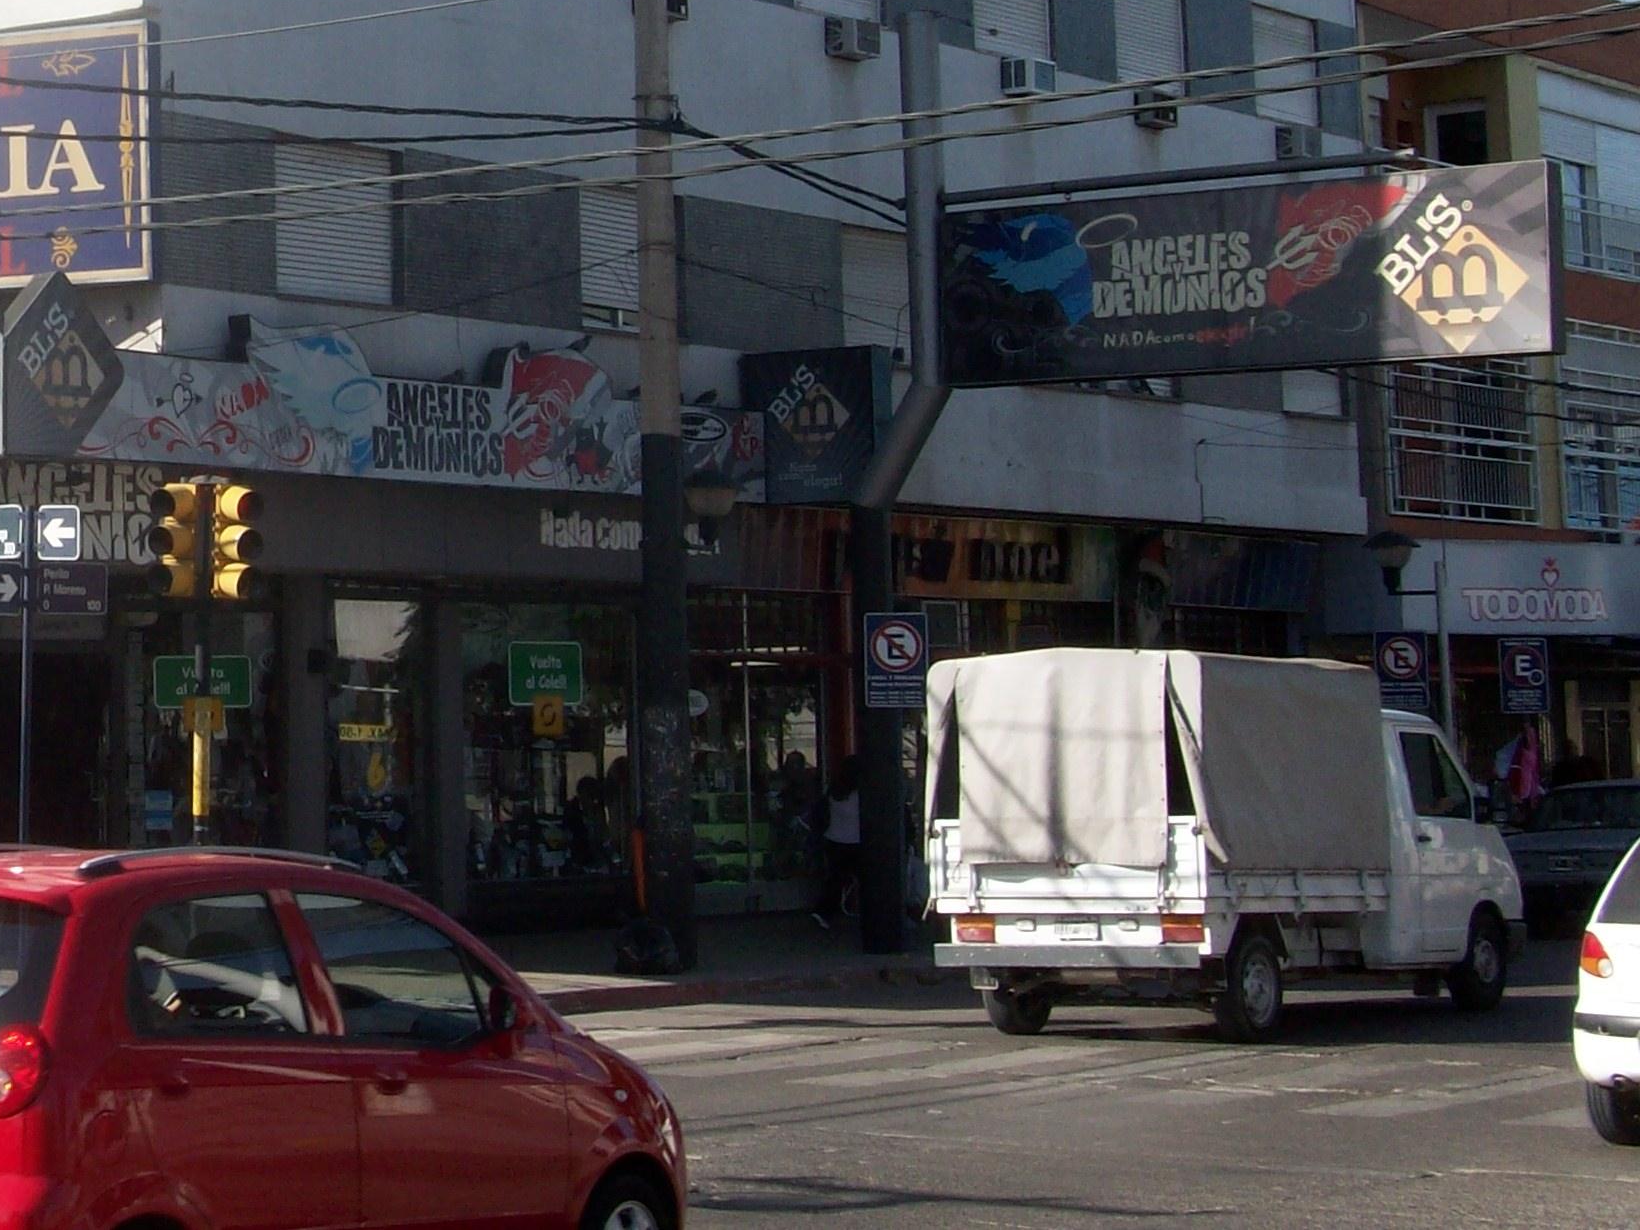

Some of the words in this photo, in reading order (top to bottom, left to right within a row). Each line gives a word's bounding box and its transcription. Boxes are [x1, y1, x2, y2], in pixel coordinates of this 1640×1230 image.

[1111, 231, 1252, 281] ANGELES
[1376, 193, 1462, 296] BL'S
[1092, 268, 1267, 319] DEMONIOS
[18, 302, 69, 379] BL'S
[1103, 330, 1153, 348] NADA
[387, 382, 491, 430] ANGELES
[767, 364, 815, 423] BL'S
[372, 425, 503, 478] DEMONIOS
[595, 517, 643, 551] com
[86, 600, 102, 611] 100
[1463, 588, 1608, 621] TODOMODA
[182, 666, 224, 679] Vuta
[529, 655, 563, 669] Vuelta
[175, 681, 188, 695] al
[525, 674, 536, 689] al
